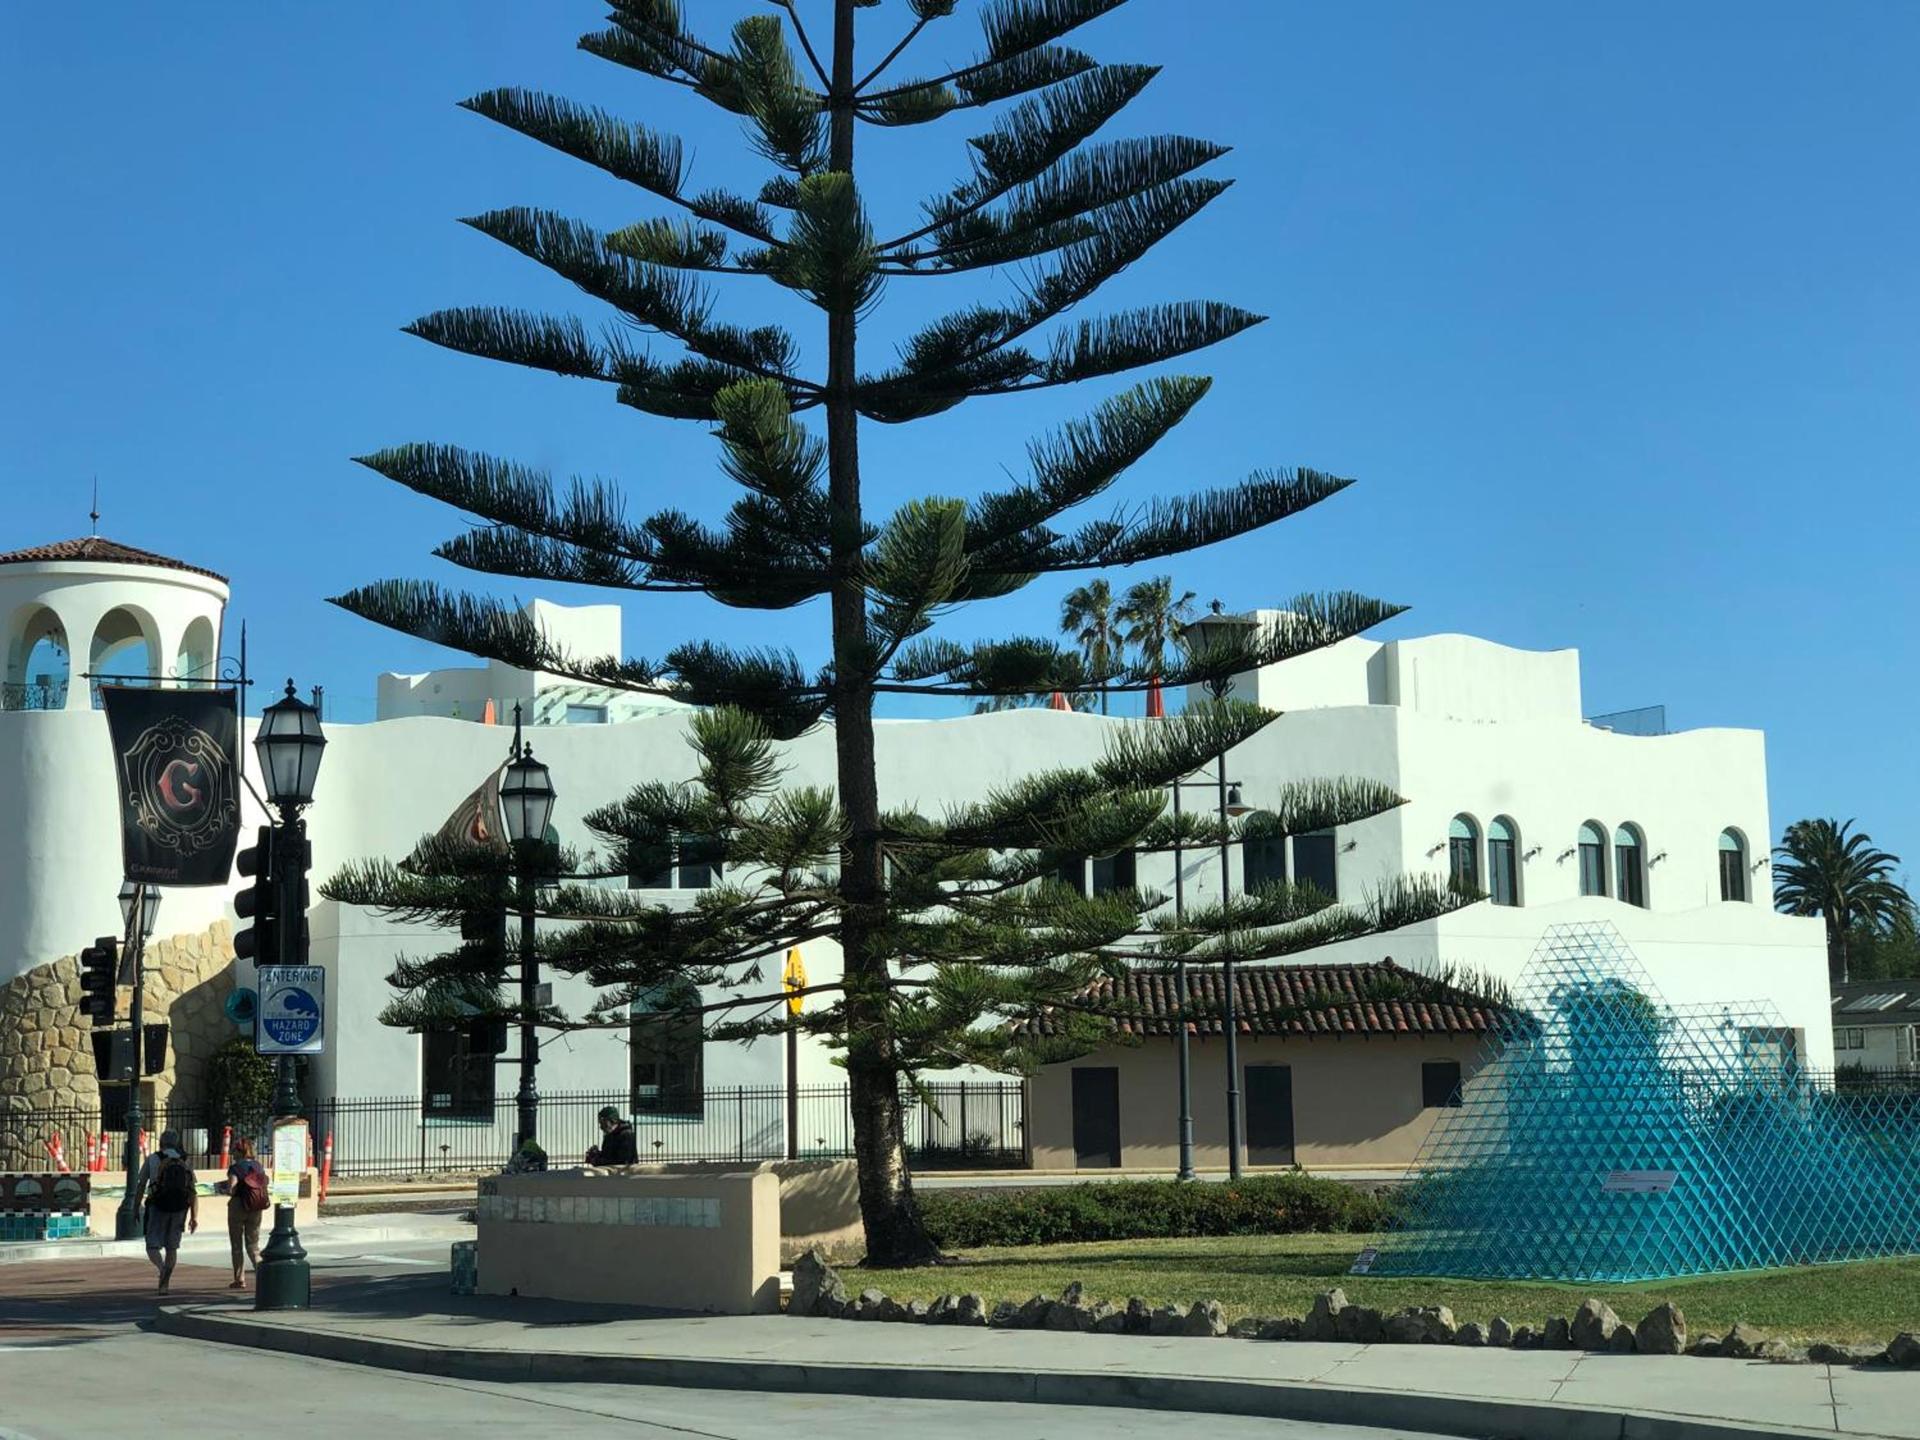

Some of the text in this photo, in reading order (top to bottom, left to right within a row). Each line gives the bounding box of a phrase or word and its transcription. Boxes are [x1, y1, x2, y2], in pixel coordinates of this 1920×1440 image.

[158, 759, 204, 812] G
[266, 970, 317, 982] ENTERING
[272, 1020, 309, 1030] HAZARD
[279, 1032, 304, 1041] ZONE
